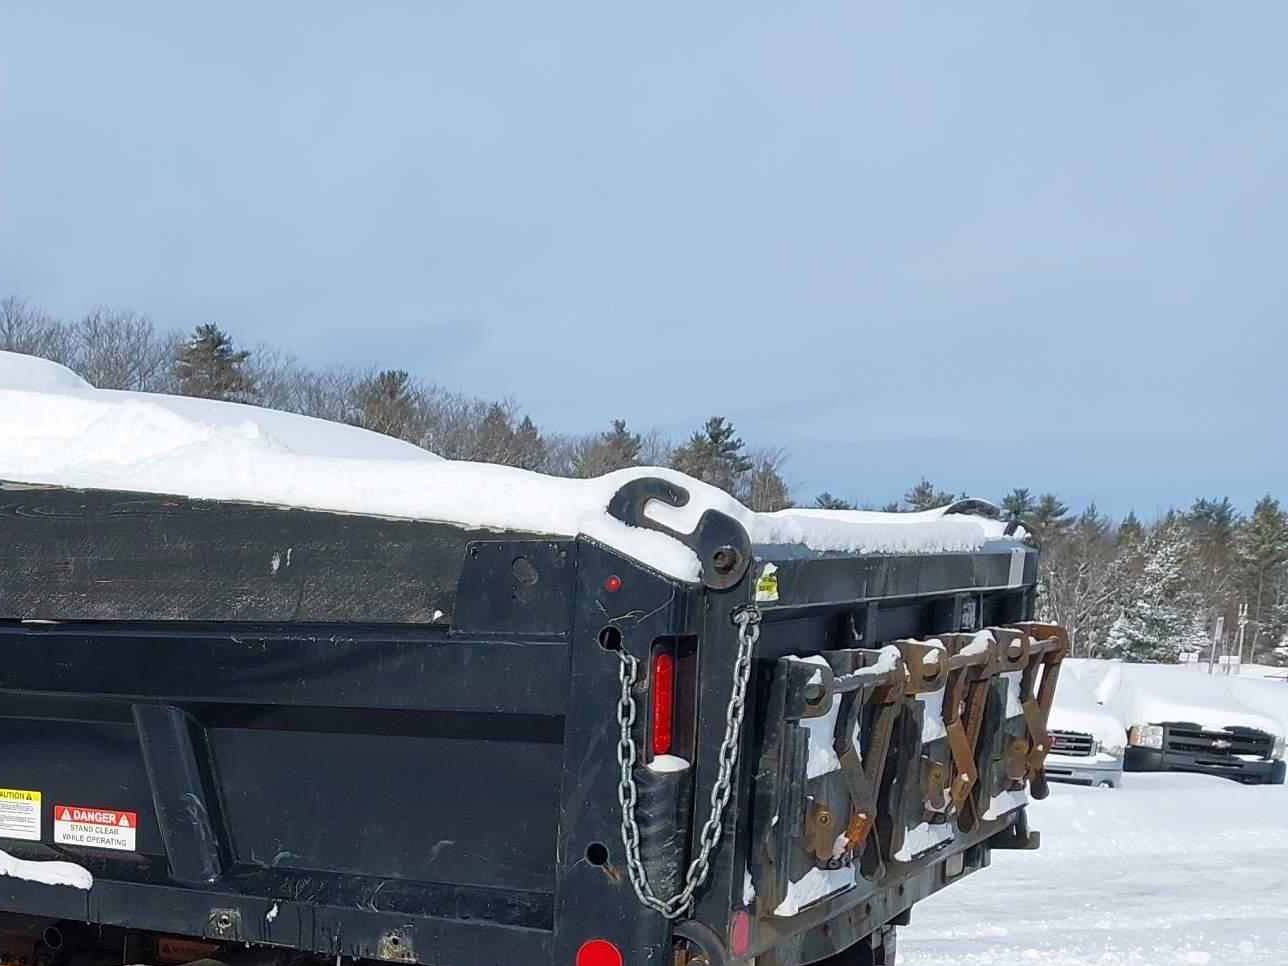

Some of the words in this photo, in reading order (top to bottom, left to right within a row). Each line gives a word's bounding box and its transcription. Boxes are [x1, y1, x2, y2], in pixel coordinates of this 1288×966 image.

[73, 810, 117, 824] DANGER
[70, 823, 94, 833] STAND
[95, 827, 119, 836] CLEAR
[62, 833, 85, 841] WHILE
[86, 836, 127, 847] OPERATING
